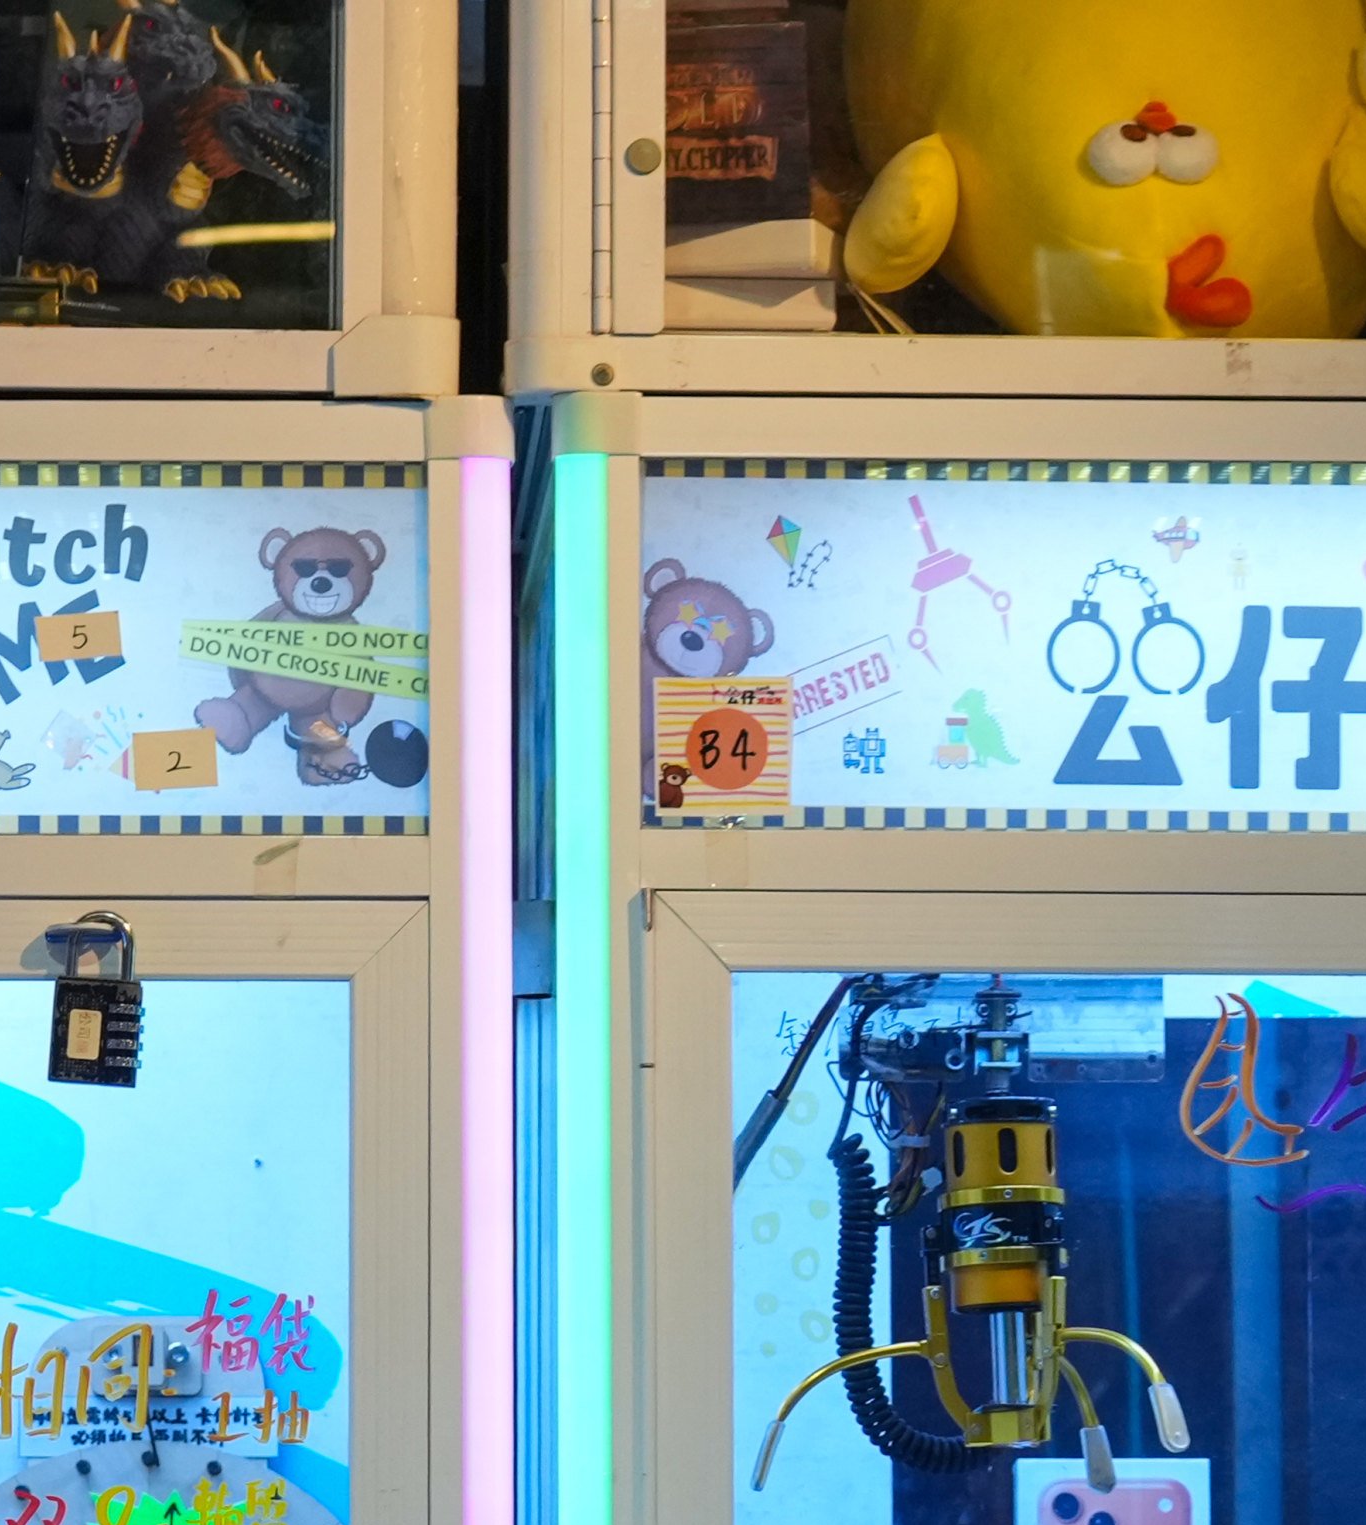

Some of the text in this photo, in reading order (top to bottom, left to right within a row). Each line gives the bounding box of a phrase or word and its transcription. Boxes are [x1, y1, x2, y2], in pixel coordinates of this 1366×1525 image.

[71, 624, 88, 650] 5
[326, 631, 357, 648] DO
[363, 632, 408, 649] NOT
[190, 636, 221, 656] DO
[227, 643, 272, 665] NOT
[277, 652, 339, 679] CROSS
[345, 664, 390, 687] LINE
[793, 652, 891, 720] RRESTED
[165, 750, 192, 773] 2
[700, 728, 756, 771] B4
[185, 1289, 315, 1376] 福袋
